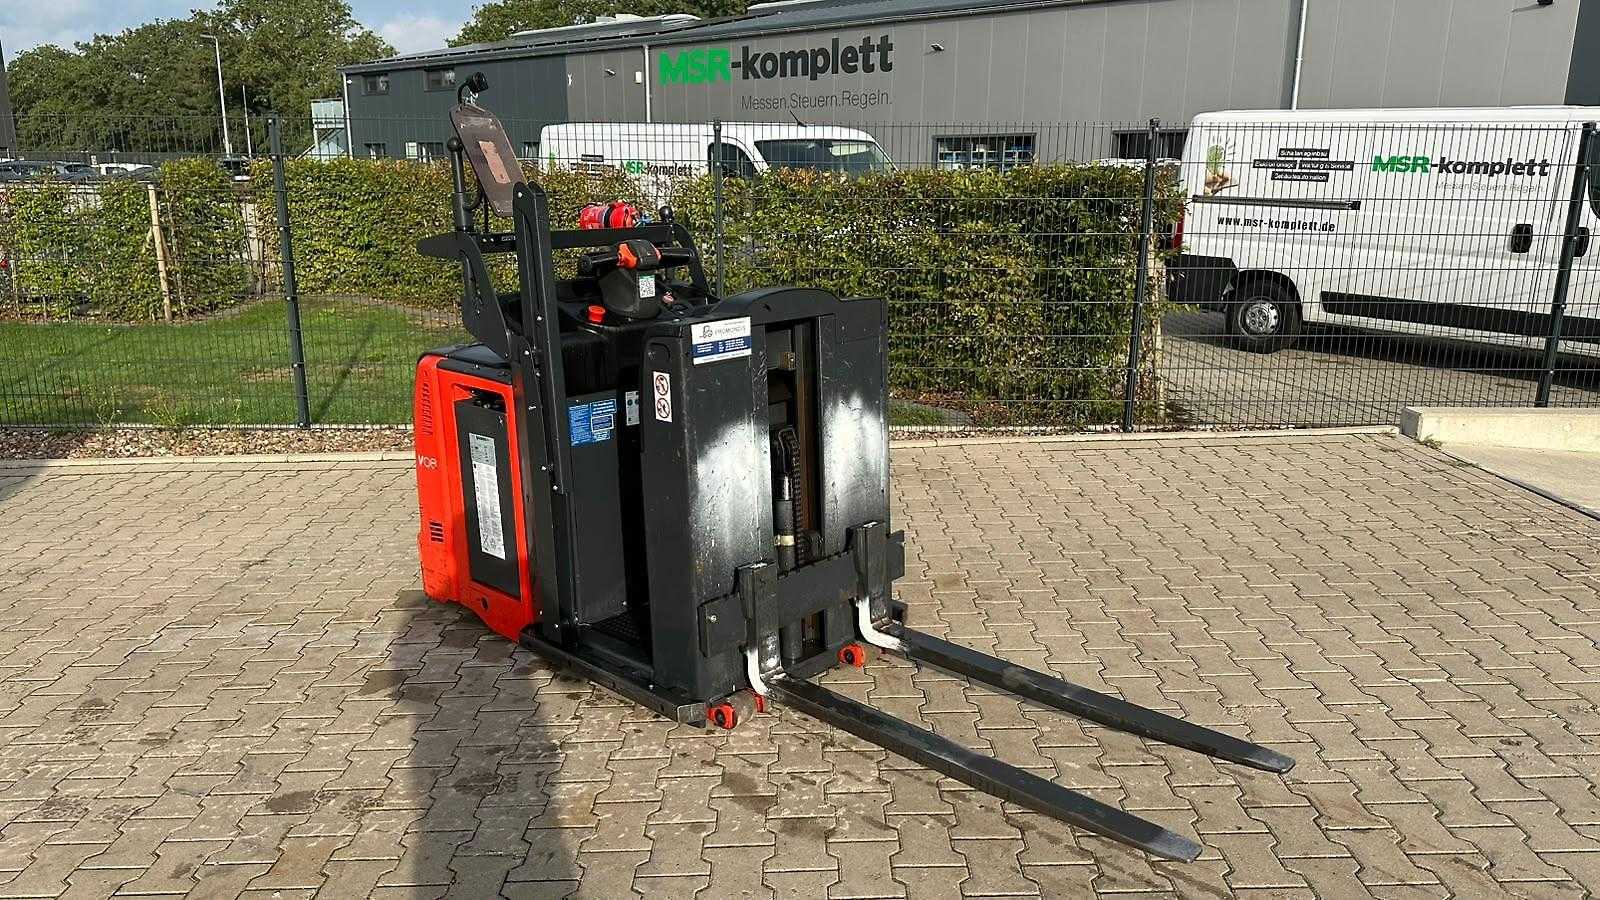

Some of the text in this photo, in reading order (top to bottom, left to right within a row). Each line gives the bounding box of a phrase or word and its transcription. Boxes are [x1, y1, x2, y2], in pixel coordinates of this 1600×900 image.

[659, 35, 894, 86] MSR-komplett
[1371, 155, 1550, 177] MSR-komplett
[1217, 216, 1336, 232] www.msr-komplett.de
